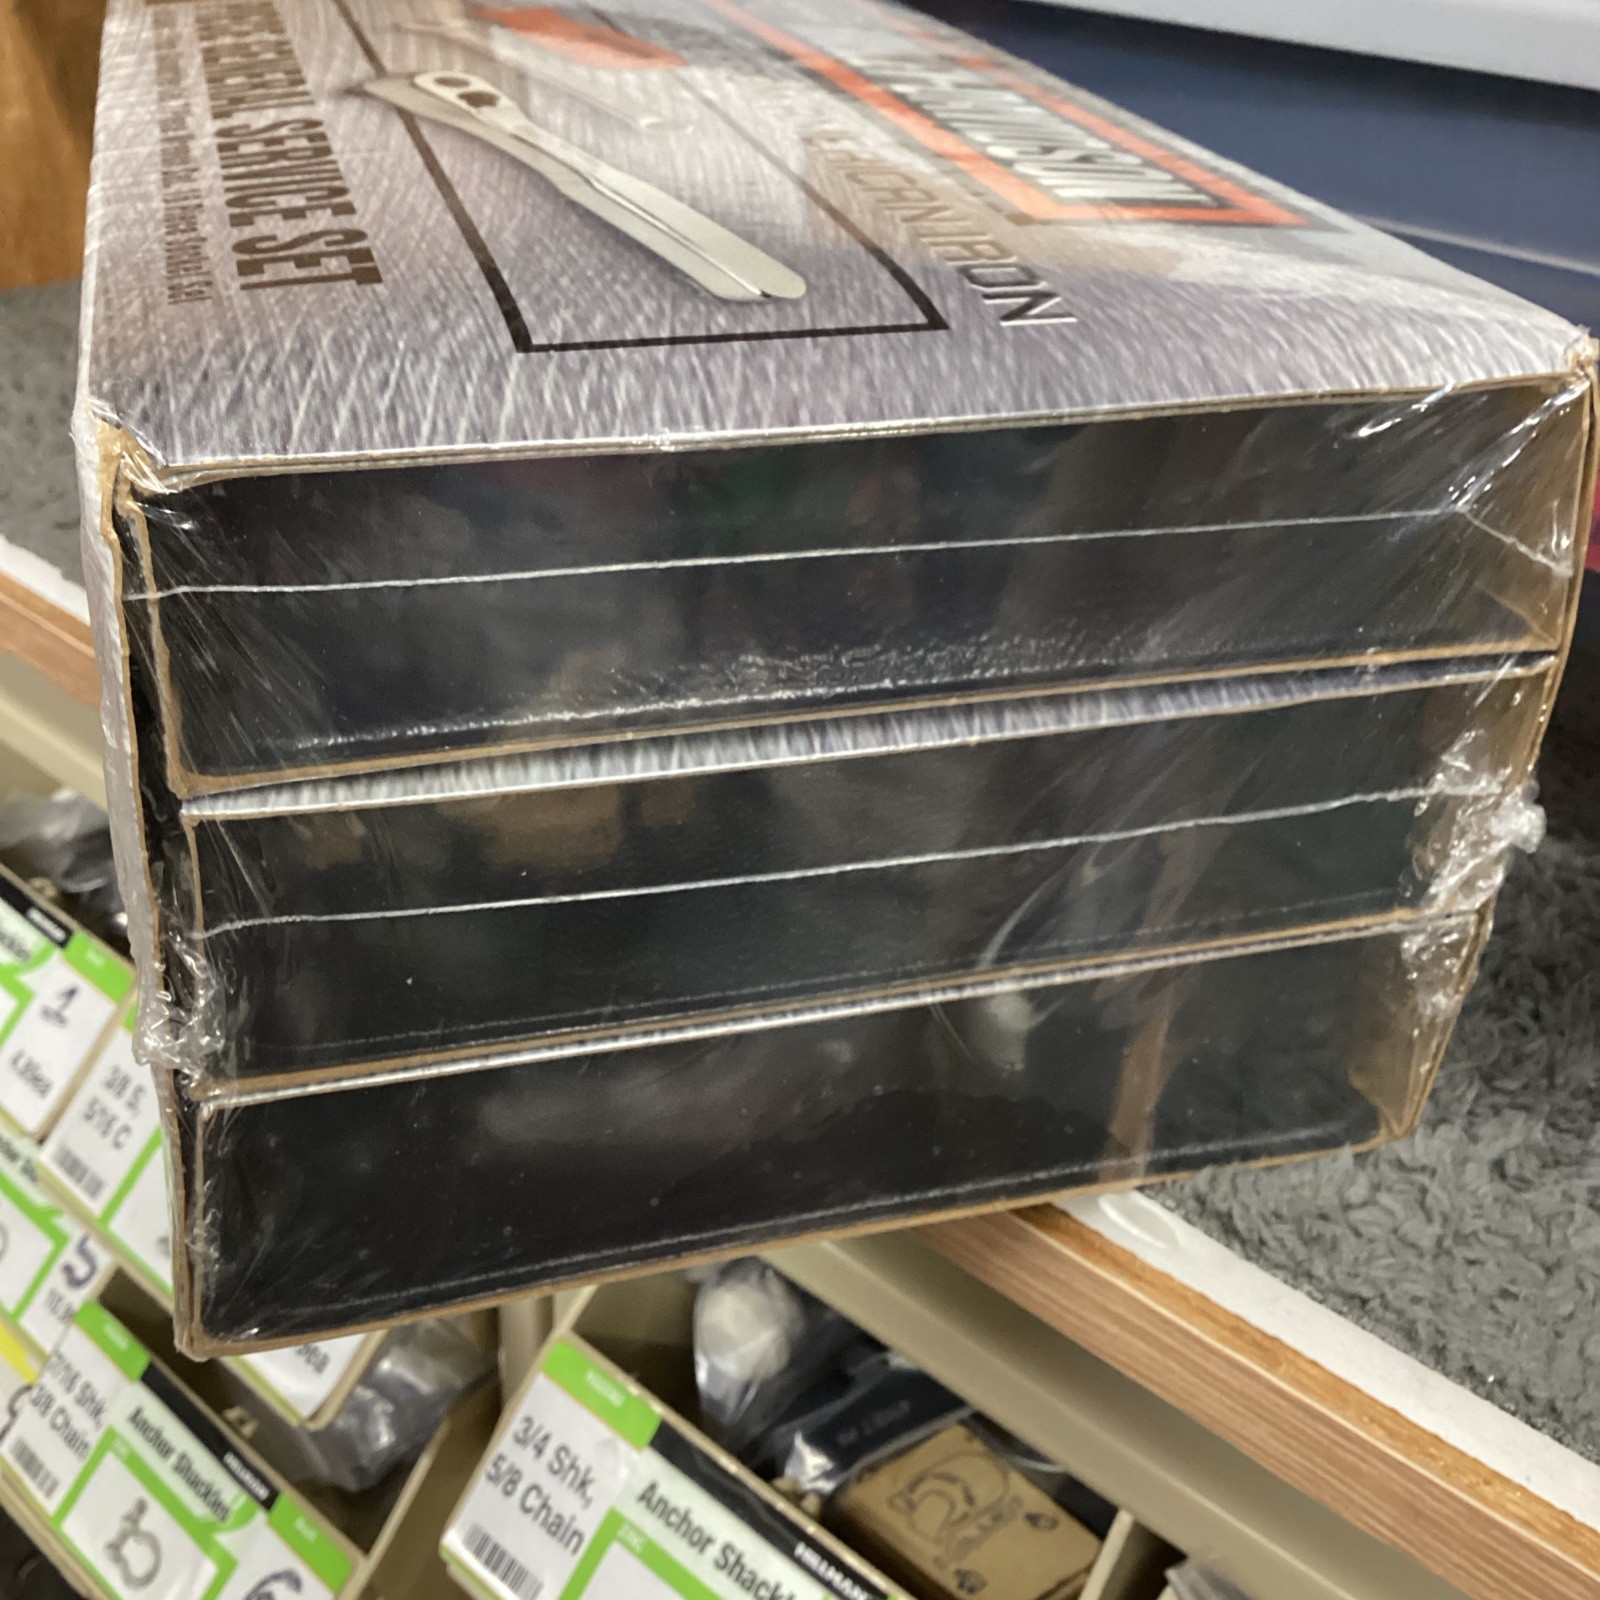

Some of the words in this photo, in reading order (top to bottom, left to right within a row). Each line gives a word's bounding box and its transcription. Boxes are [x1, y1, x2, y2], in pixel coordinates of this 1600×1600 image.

[213, 118, 358, 228] SERVICE
[231, 228, 384, 291] SET
[484, 1452, 523, 1498] 5/8
[518, 1483, 585, 1557] Chain
[512, 1415, 552, 1460] 3/4
[547, 1442, 595, 1510] Shk,
[636, 1470, 716, 1554] Anchor
